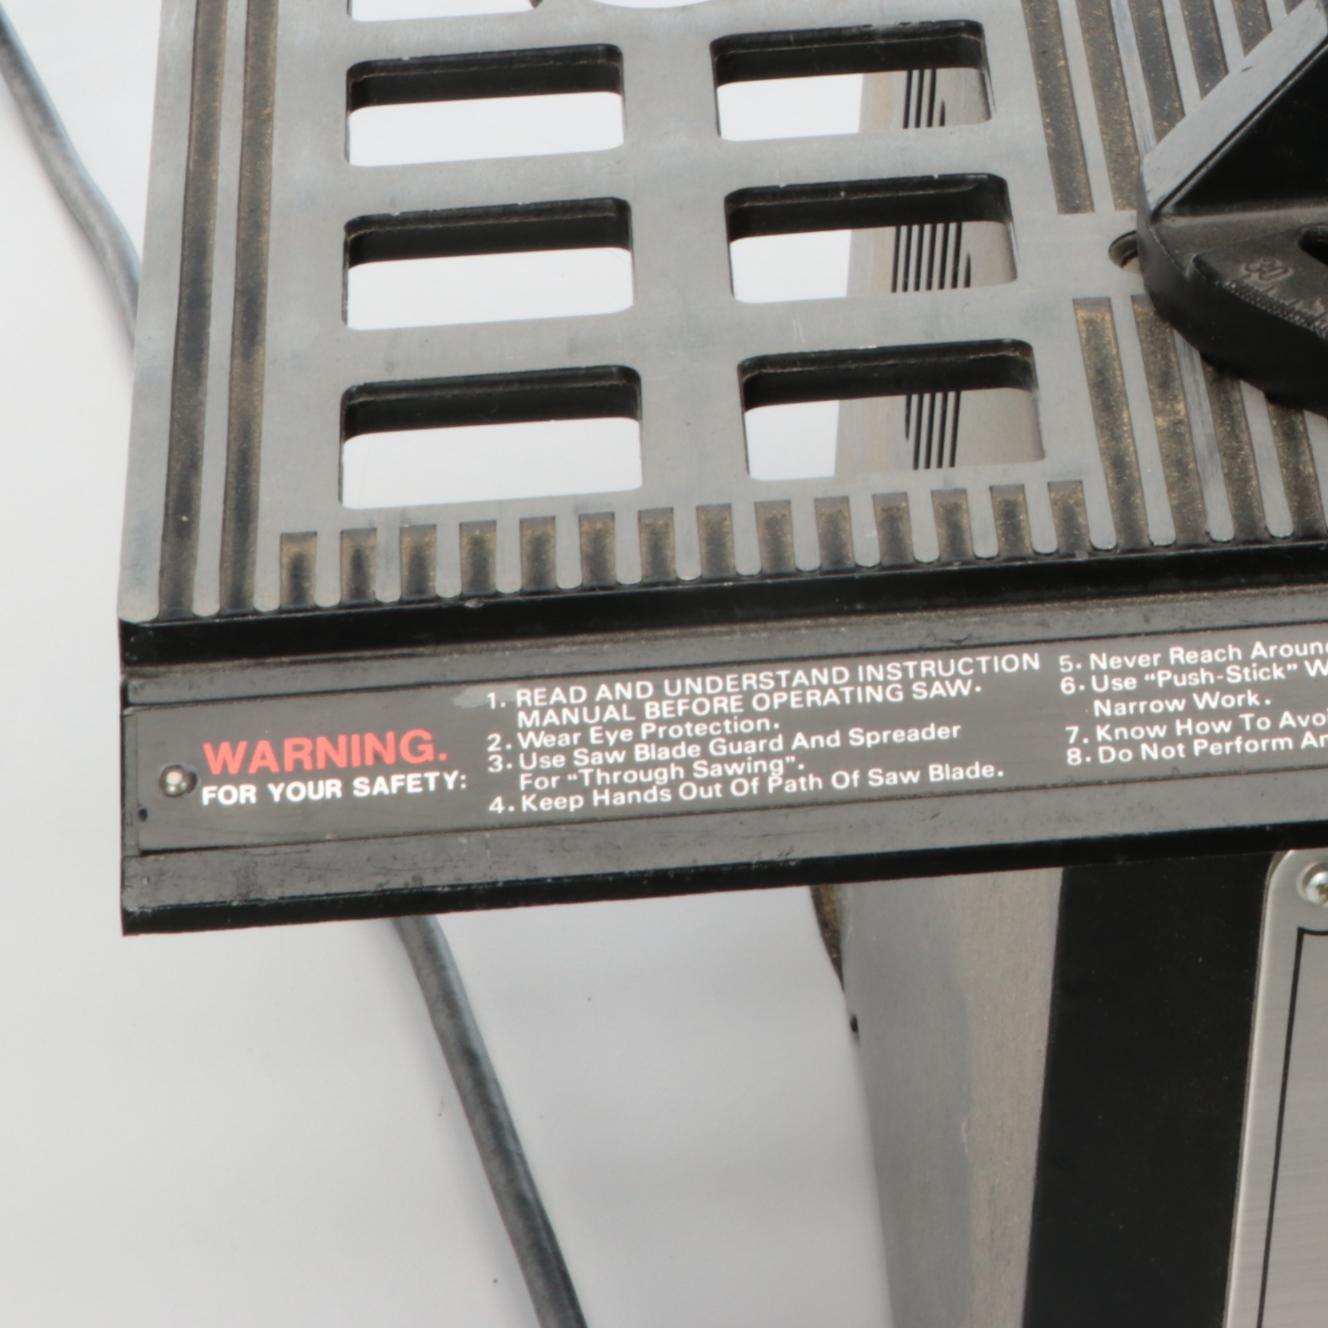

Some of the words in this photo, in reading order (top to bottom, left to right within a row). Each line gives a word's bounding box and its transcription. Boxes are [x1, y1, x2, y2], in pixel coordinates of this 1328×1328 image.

[1059, 655, 1082, 673] 5.
[1089, 652, 1161, 670] Never
[1169, 644, 1242, 665] Reach
[486, 691, 506, 709] 1.
[515, 686, 587, 708] READ
[595, 681, 654, 702] AND
[664, 666, 850, 697] UNDERSTAND
[858, 652, 1040, 682] INSTRUCTION
[1060, 676, 1085, 695] 6.
[1091, 674, 1137, 692] Use
[518, 703, 635, 728] MANUAL
[644, 695, 744, 720] BEFORE
[752, 683, 904, 712] OPERATING
[912, 679, 981, 700] SAW.
[1093, 698, 1186, 717] Narrow
[1192, 689, 1271, 710] Work.
[487, 733, 512, 752] 2.
[517, 730, 581, 749] Wear
[590, 726, 633, 746] Eye
[641, 716, 779, 740] Protection.
[1065, 725, 1089, 744] 7.
[1096, 724, 1167, 742] Know
[1175, 718, 1232, 736] How
[1239, 713, 1271, 731] To
[203, 729, 449, 775] WARNING.
[488, 754, 512, 773] 3.
[519, 752, 566, 770] Use
[573, 748, 626, 767] Saw
[634, 741, 701, 762] Blade
[709, 734, 783, 756] Guard
[791, 730, 841, 750] And
[848, 723, 961, 748] Spreader
[1067, 747, 1091, 766] 8.
[1098, 745, 1133, 764] Do
[1140, 742, 1185, 760] Not
[1193, 736, 1293, 756] Perform
[202, 783, 257, 806] FOR
[267, 780, 343, 803] YOUR
[353, 770, 467, 797] SAFETY:
[489, 796, 515, 814] 4.
[521, 794, 584, 812] Keep
[593, 785, 672, 807] Hands
[678, 781, 722, 801] Out
[730, 777, 759, 797] Of
[768, 771, 823, 794] Path
[831, 769, 860, 790] Of
[868, 768, 920, 787] Saw
[928, 761, 1004, 782] Blade.
[520, 773, 560, 791] For
